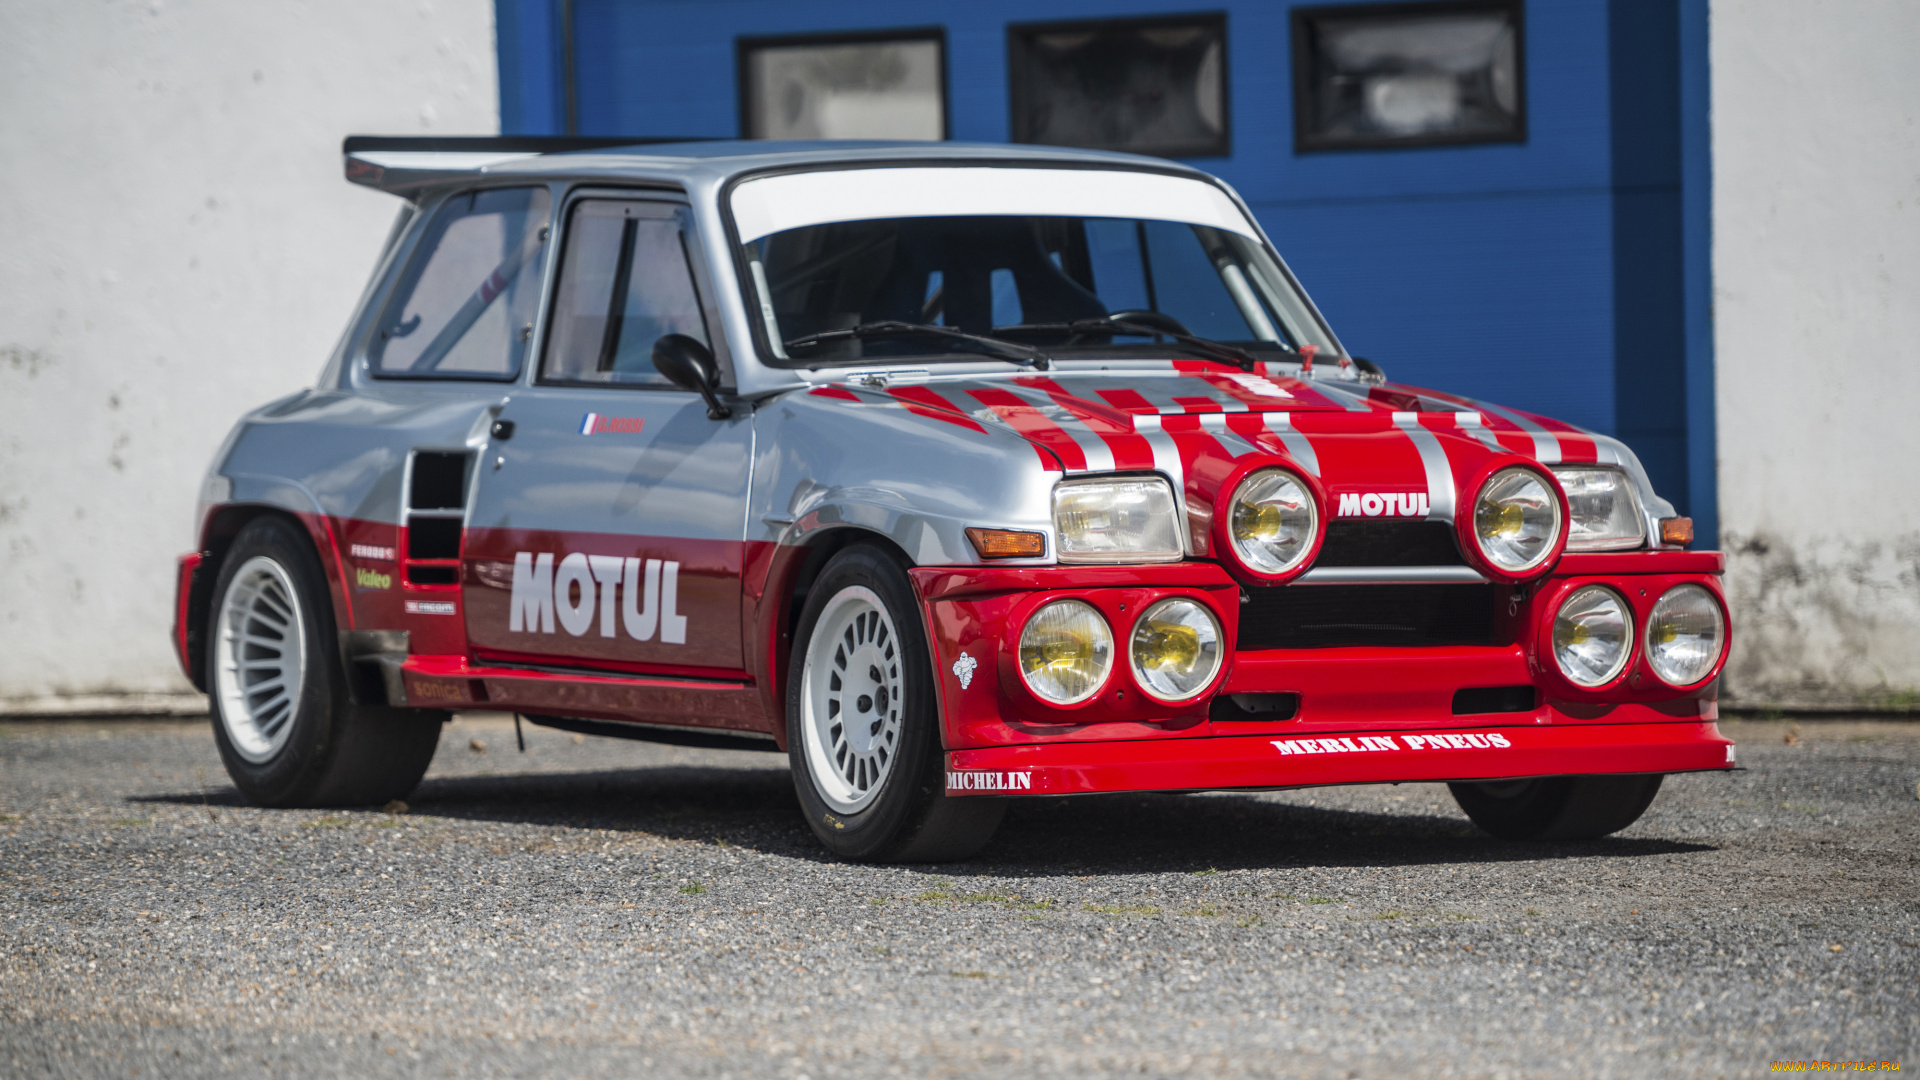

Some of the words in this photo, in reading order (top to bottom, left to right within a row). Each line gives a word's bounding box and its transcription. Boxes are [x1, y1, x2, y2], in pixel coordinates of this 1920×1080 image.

[1338, 492, 1430, 516] MOTUL
[509, 551, 687, 644] MOTUL
[1270, 736, 1400, 755] MERLIN
[1400, 732, 1512, 750] PNEUS
[946, 771, 1032, 790] MICHELIN
